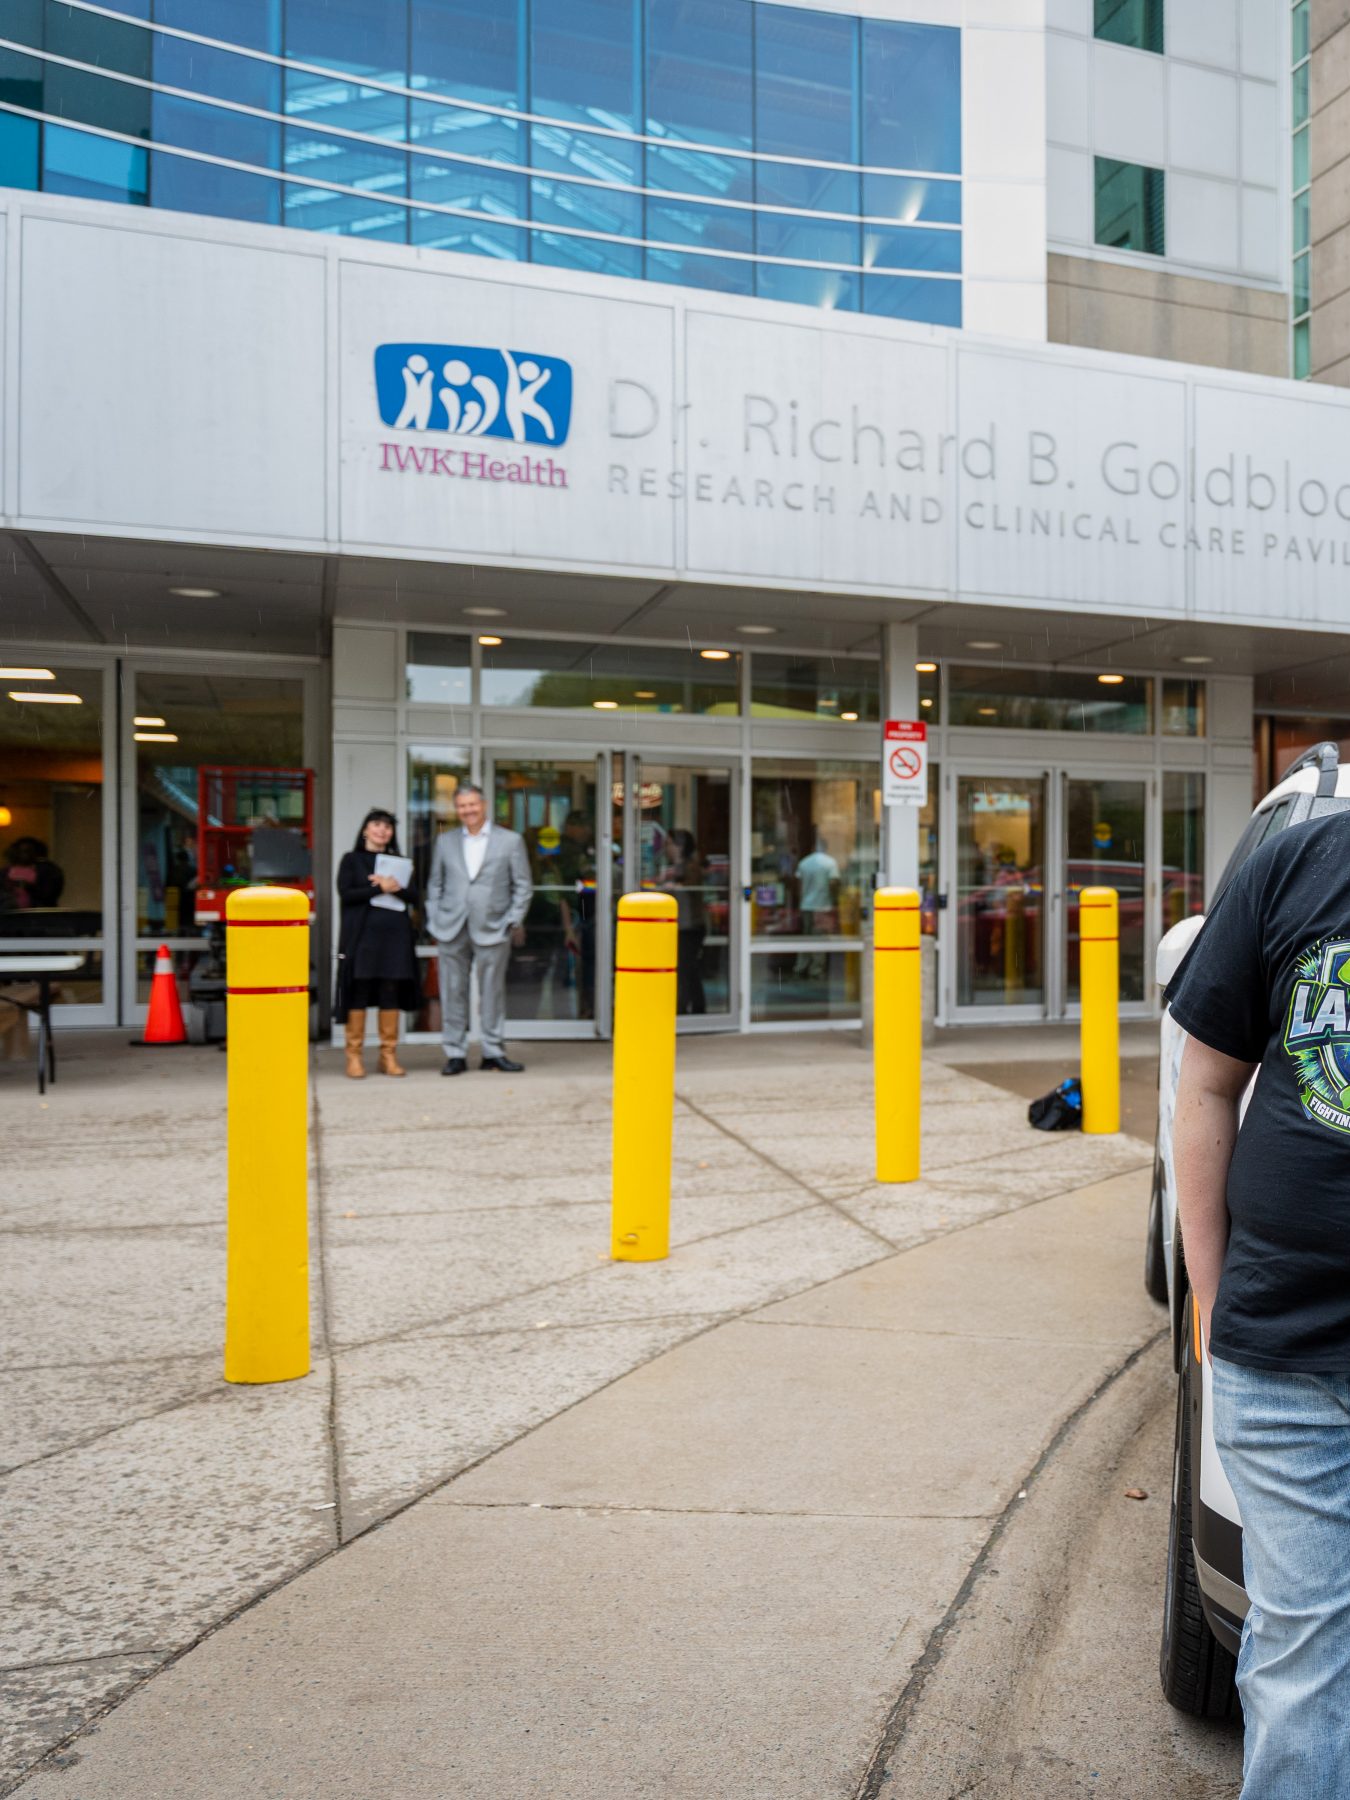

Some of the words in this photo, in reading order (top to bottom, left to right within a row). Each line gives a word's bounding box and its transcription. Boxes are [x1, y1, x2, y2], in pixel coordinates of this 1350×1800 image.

[379, 443, 455, 476] IWK
[461, 451, 568, 488] Health
[608, 378, 708, 448] Dr.
[743, 393, 997, 480] Richard
[1028, 431, 1075, 490] B.
[608, 463, 836, 515] RESEARCH
[860, 490, 944, 525] AND
[965, 502, 1141, 545] CLINICAL
[1159, 523, 1246, 555] CARE
